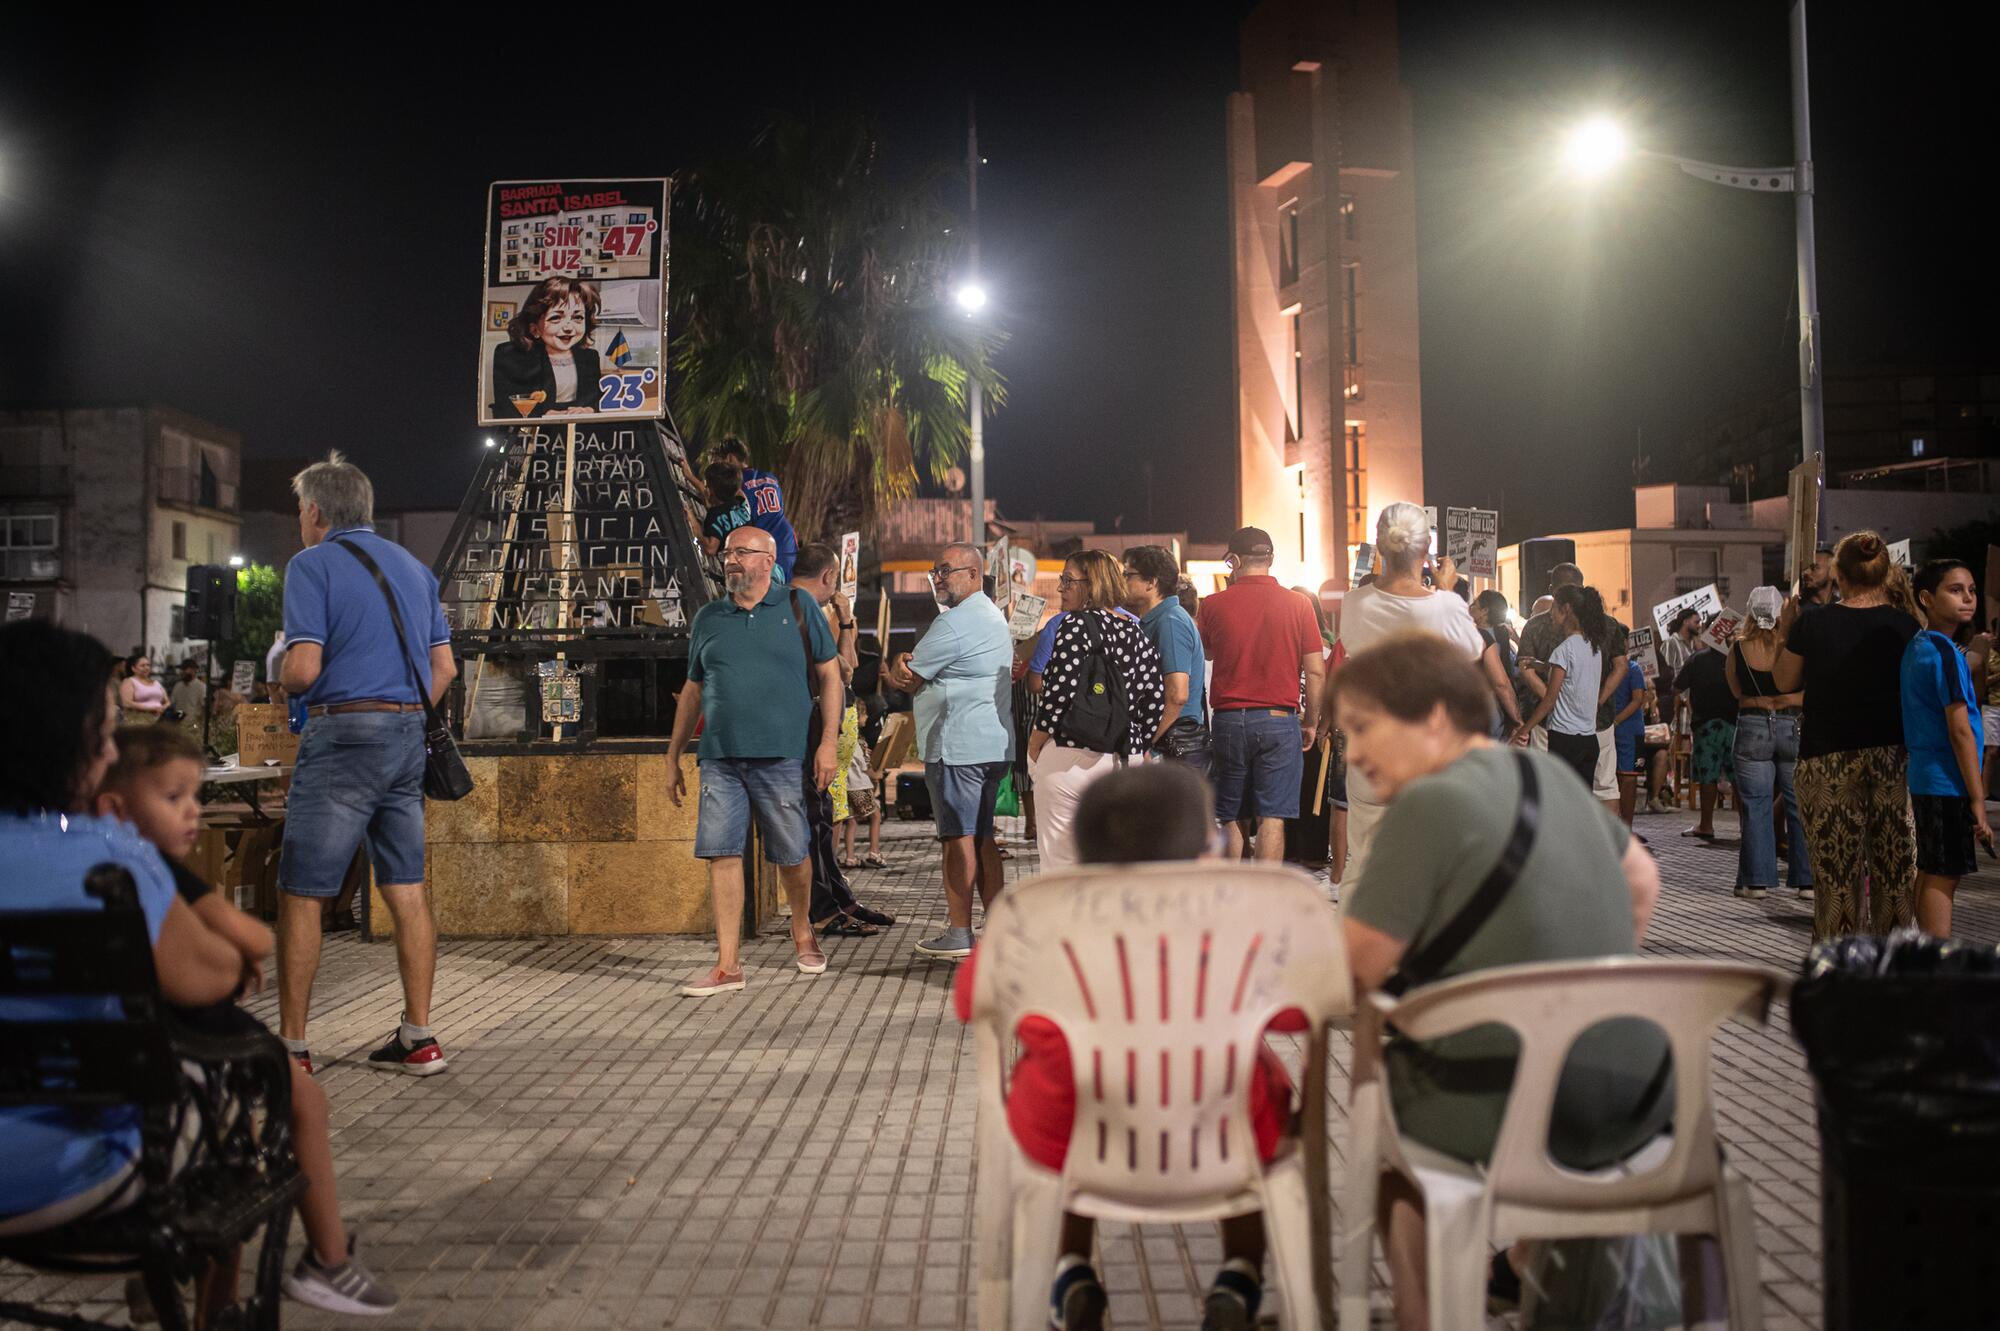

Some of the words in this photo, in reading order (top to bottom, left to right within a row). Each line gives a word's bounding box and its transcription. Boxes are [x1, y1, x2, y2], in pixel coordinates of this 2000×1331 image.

[499, 198, 560, 217] SANTA
[564, 191, 627, 211] ISABEL
[500, 184, 563, 201] BARRIADA
[543, 226, 580, 248] SIN
[539, 249, 581, 273] LUZ
[755, 487, 781, 516] 10
